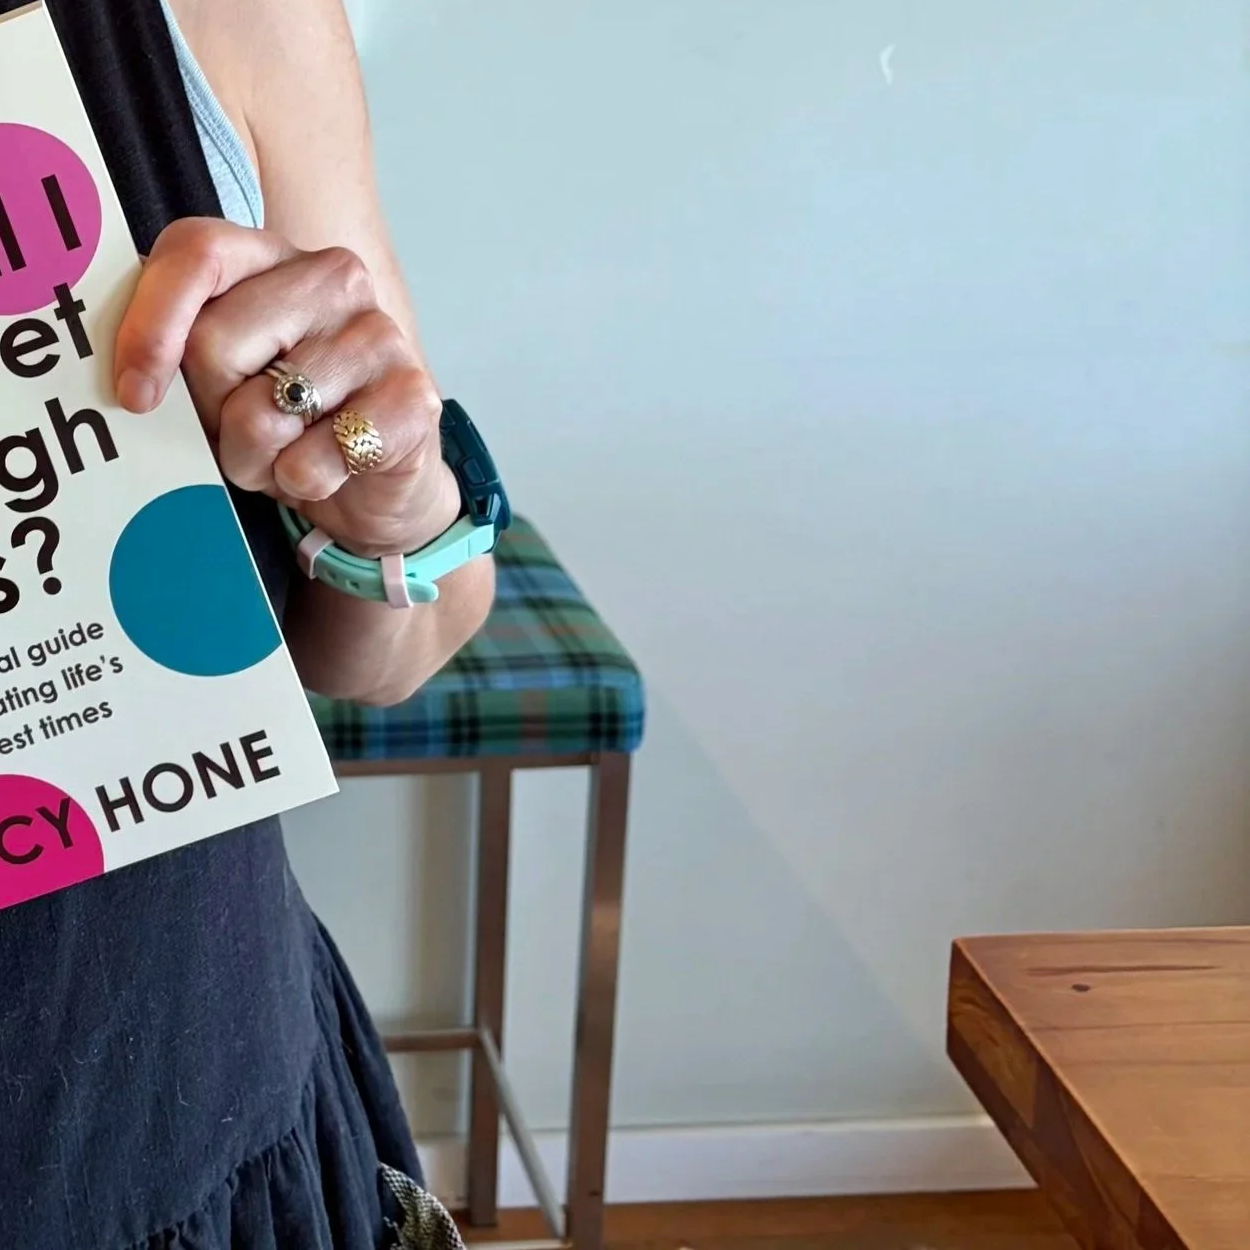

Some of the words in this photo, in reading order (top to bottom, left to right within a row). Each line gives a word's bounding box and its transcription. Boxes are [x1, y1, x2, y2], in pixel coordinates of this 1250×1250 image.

[40, 174, 82, 252] I
[27, 622, 104, 667] guide
[39, 701, 113, 740] times
[95, 729, 281, 832] HONE
